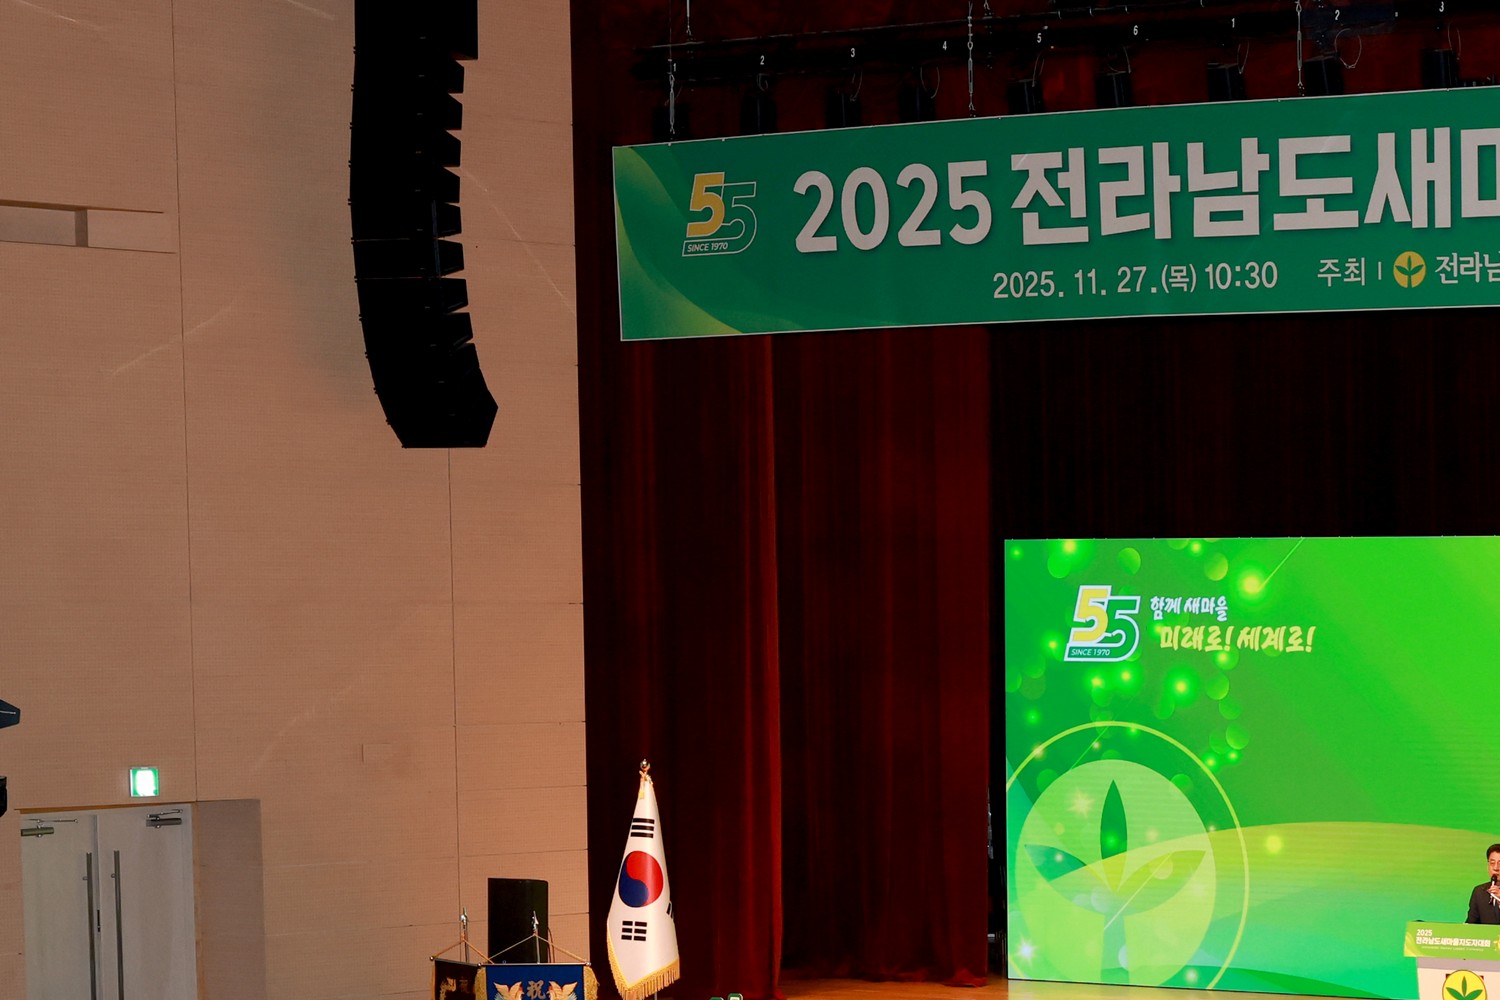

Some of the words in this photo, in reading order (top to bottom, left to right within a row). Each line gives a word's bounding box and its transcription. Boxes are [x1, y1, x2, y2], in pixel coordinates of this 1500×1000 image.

[1439, 1, 1445, 12] 3
[1334, 9, 1340, 21] 2
[1231, 17, 1236, 29] 1
[1132, 24, 1139, 36] 6
[1036, 32, 1042, 43] 5
[942, 40, 948, 51] 4
[850, 47, 856, 58] 3
[759, 55, 765, 65] 2
[672, 62, 677, 72] 1
[686, 171, 757, 250] 55
[793, 160, 993, 253] 2025
[687, 242, 709, 253] SINCE
[710, 241, 729, 251] 1970
[992, 270, 1065, 299] 2025.
[1074, 268, 1107, 296] 11.
[1205, 261, 1279, 290] 10:30
[1317, 257, 1367, 288] 주최
[1150, 596, 1181, 621] 함께
[1183, 595, 1228, 622] 새마을
[1073, 585, 1141, 650] 55
[1160, 625, 1234, 652] 미래로!
[1236, 625, 1316, 653] 세계로!
[1071, 648, 1092, 657] SINCE
[1093, 648, 1111, 657] 1970
[1416, 929, 1433, 937] 2025
